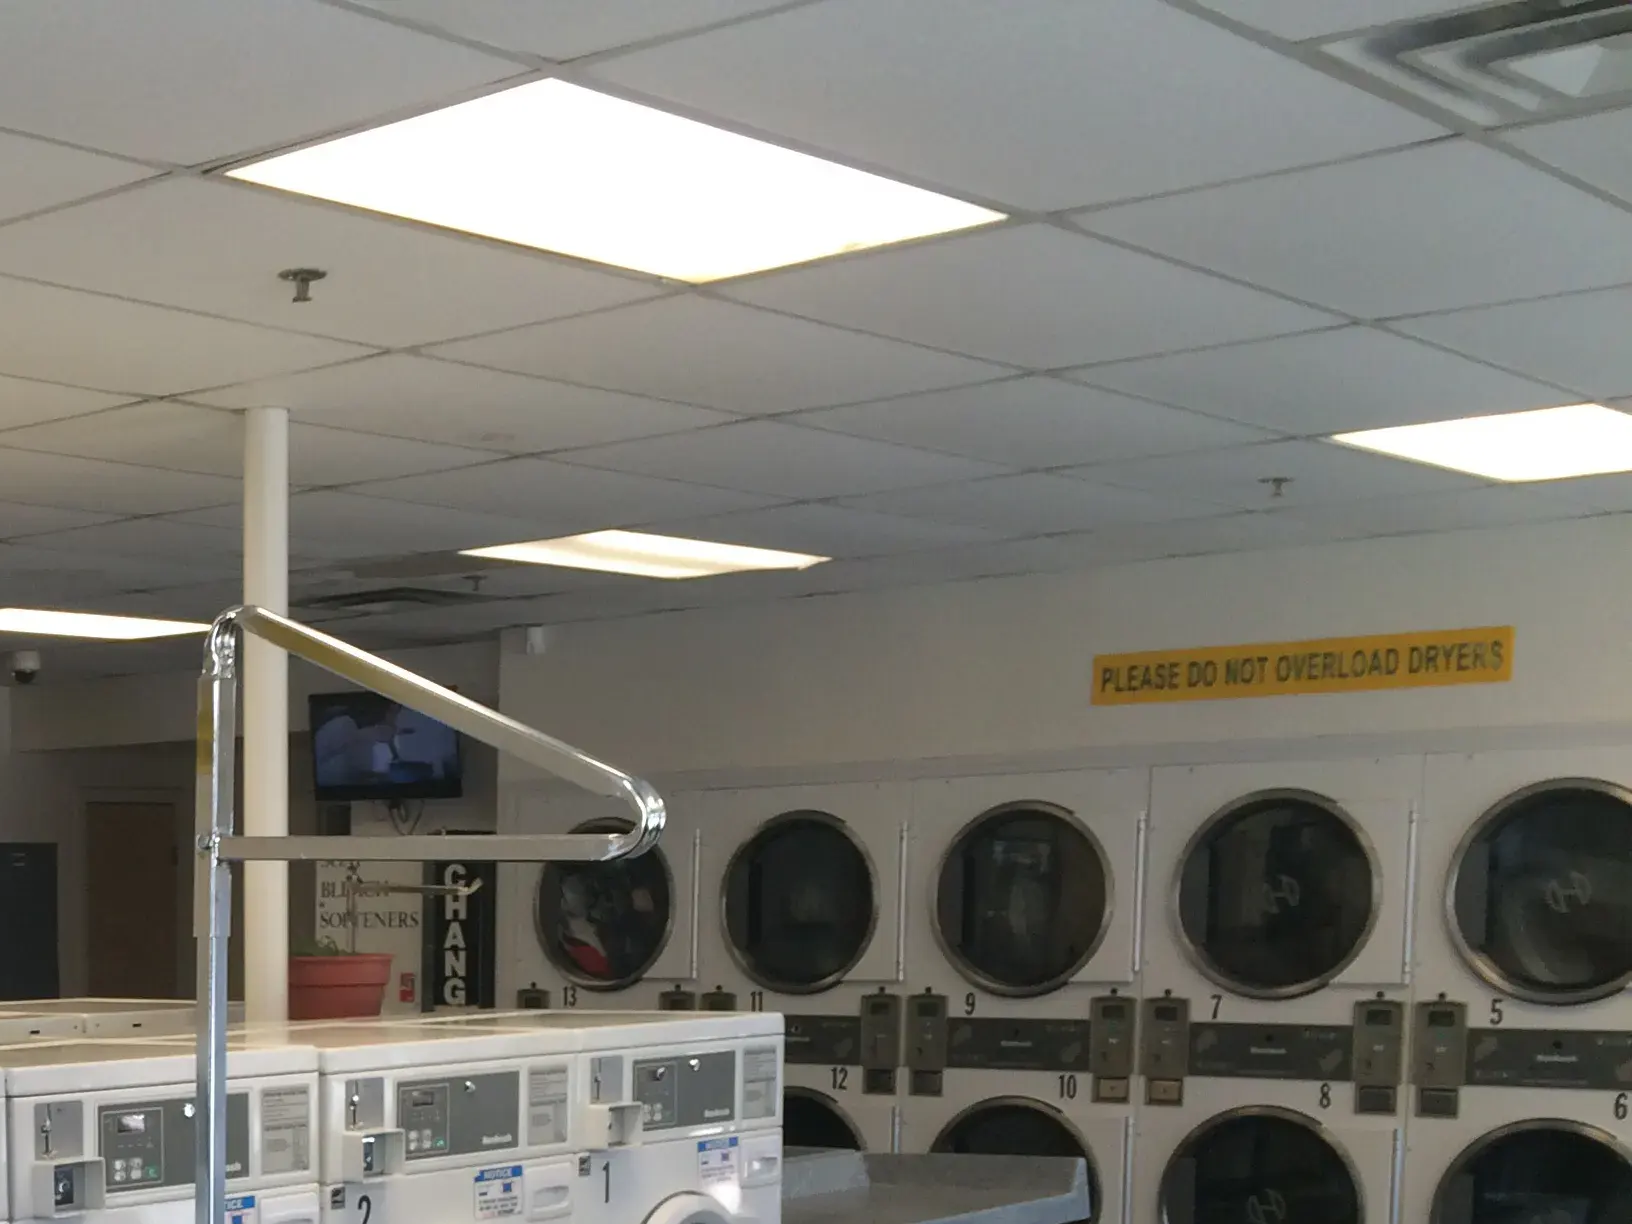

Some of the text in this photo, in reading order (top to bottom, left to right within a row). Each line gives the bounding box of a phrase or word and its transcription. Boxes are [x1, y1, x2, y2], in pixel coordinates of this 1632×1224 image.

[1101, 640, 1505, 693] PLEASE DO NOT OVERLOAD DRYERS
[563, 985, 578, 1008] 13
[750, 991, 764, 1012] 11
[965, 992, 976, 1016] 9
[1210, 994, 1222, 1020] 7
[1490, 998, 1504, 1025] 5
[831, 1066, 848, 1091] 12
[1058, 1074, 1078, 1101] 10
[1319, 1082, 1332, 1110] 8
[1613, 1091, 1629, 1120] 6
[602, 1161, 610, 1204] 1
